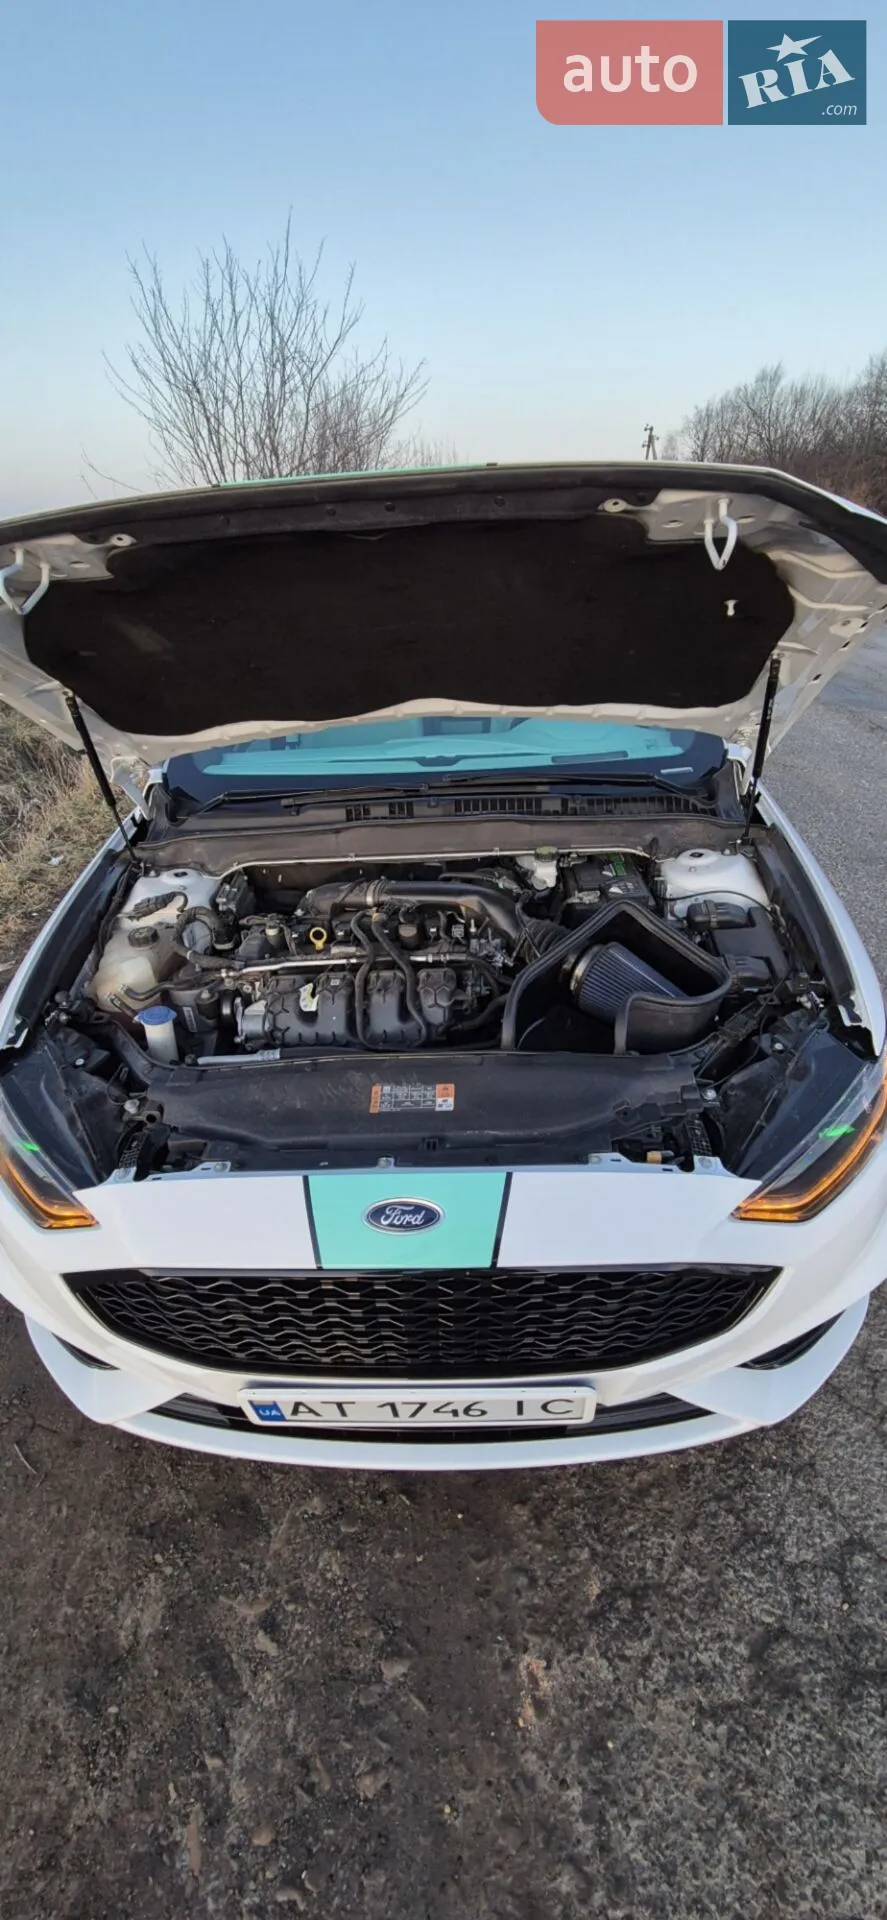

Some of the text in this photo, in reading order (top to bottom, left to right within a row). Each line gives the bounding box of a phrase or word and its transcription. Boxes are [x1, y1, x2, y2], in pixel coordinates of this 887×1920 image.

[380, 1205, 425, 1225] Ford
[257, 1407, 281, 1418] UA
[290, 1399, 575, 1418] AT 1746 IC
